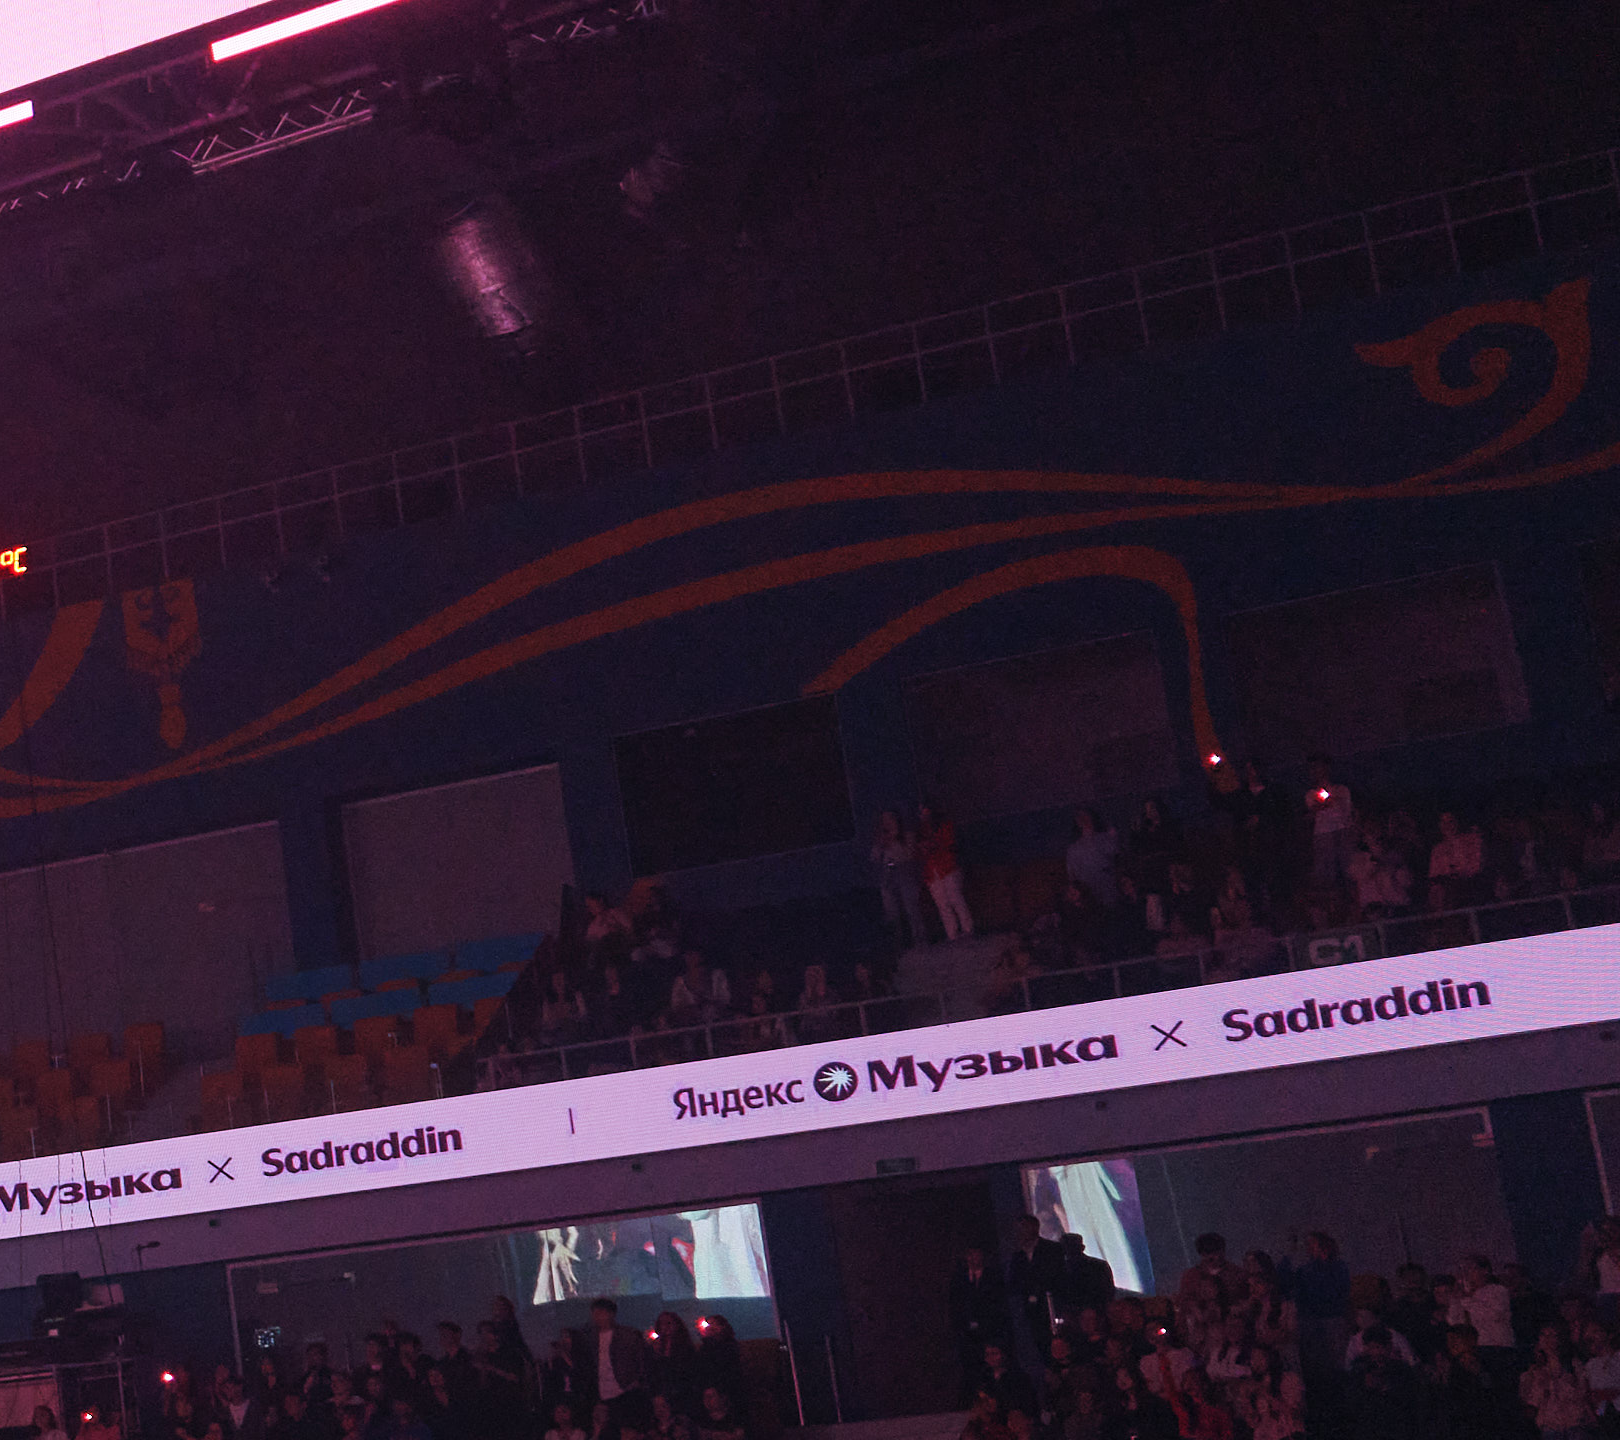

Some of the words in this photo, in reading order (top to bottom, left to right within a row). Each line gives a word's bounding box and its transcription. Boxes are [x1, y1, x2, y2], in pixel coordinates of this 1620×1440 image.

[673, 1080, 804, 1120] Яндекс
[867, 1035, 1118, 1092] Музыка
[1222, 979, 1491, 1042] Sadraddin
[262, 1128, 462, 1176] Sadraddin
